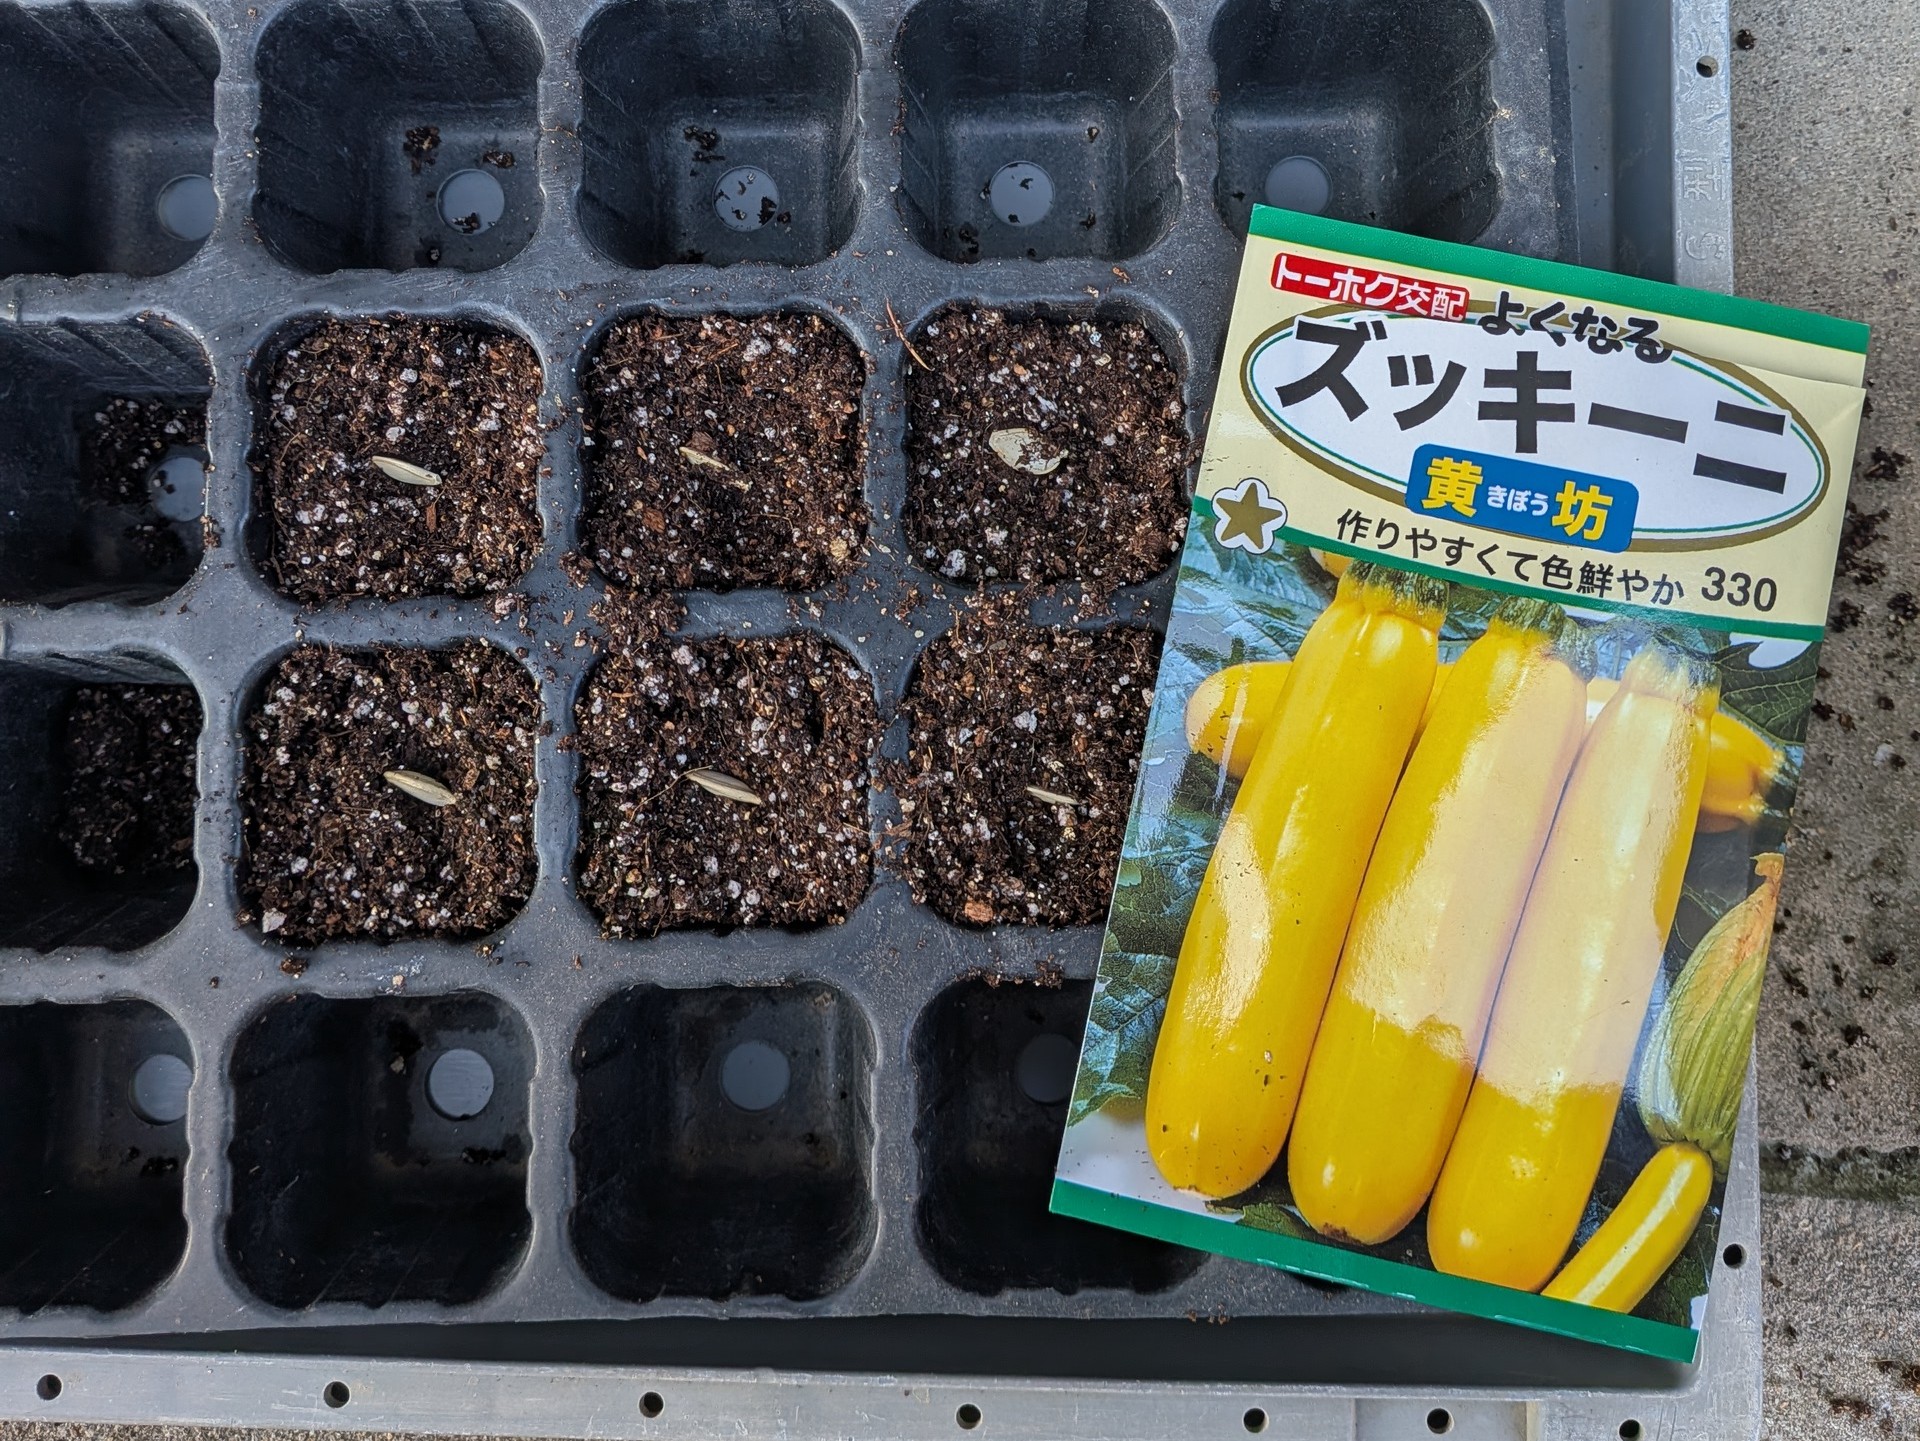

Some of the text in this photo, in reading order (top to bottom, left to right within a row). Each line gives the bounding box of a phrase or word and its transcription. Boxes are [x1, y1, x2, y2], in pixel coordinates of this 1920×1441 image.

[1275, 255, 1467, 321] トーホク交配
[1478, 291, 1673, 364] よくなる
[1275, 319, 1787, 495] ズッキーニ
[1336, 508, 1778, 613] 作りやすくて色鮮やか 330
